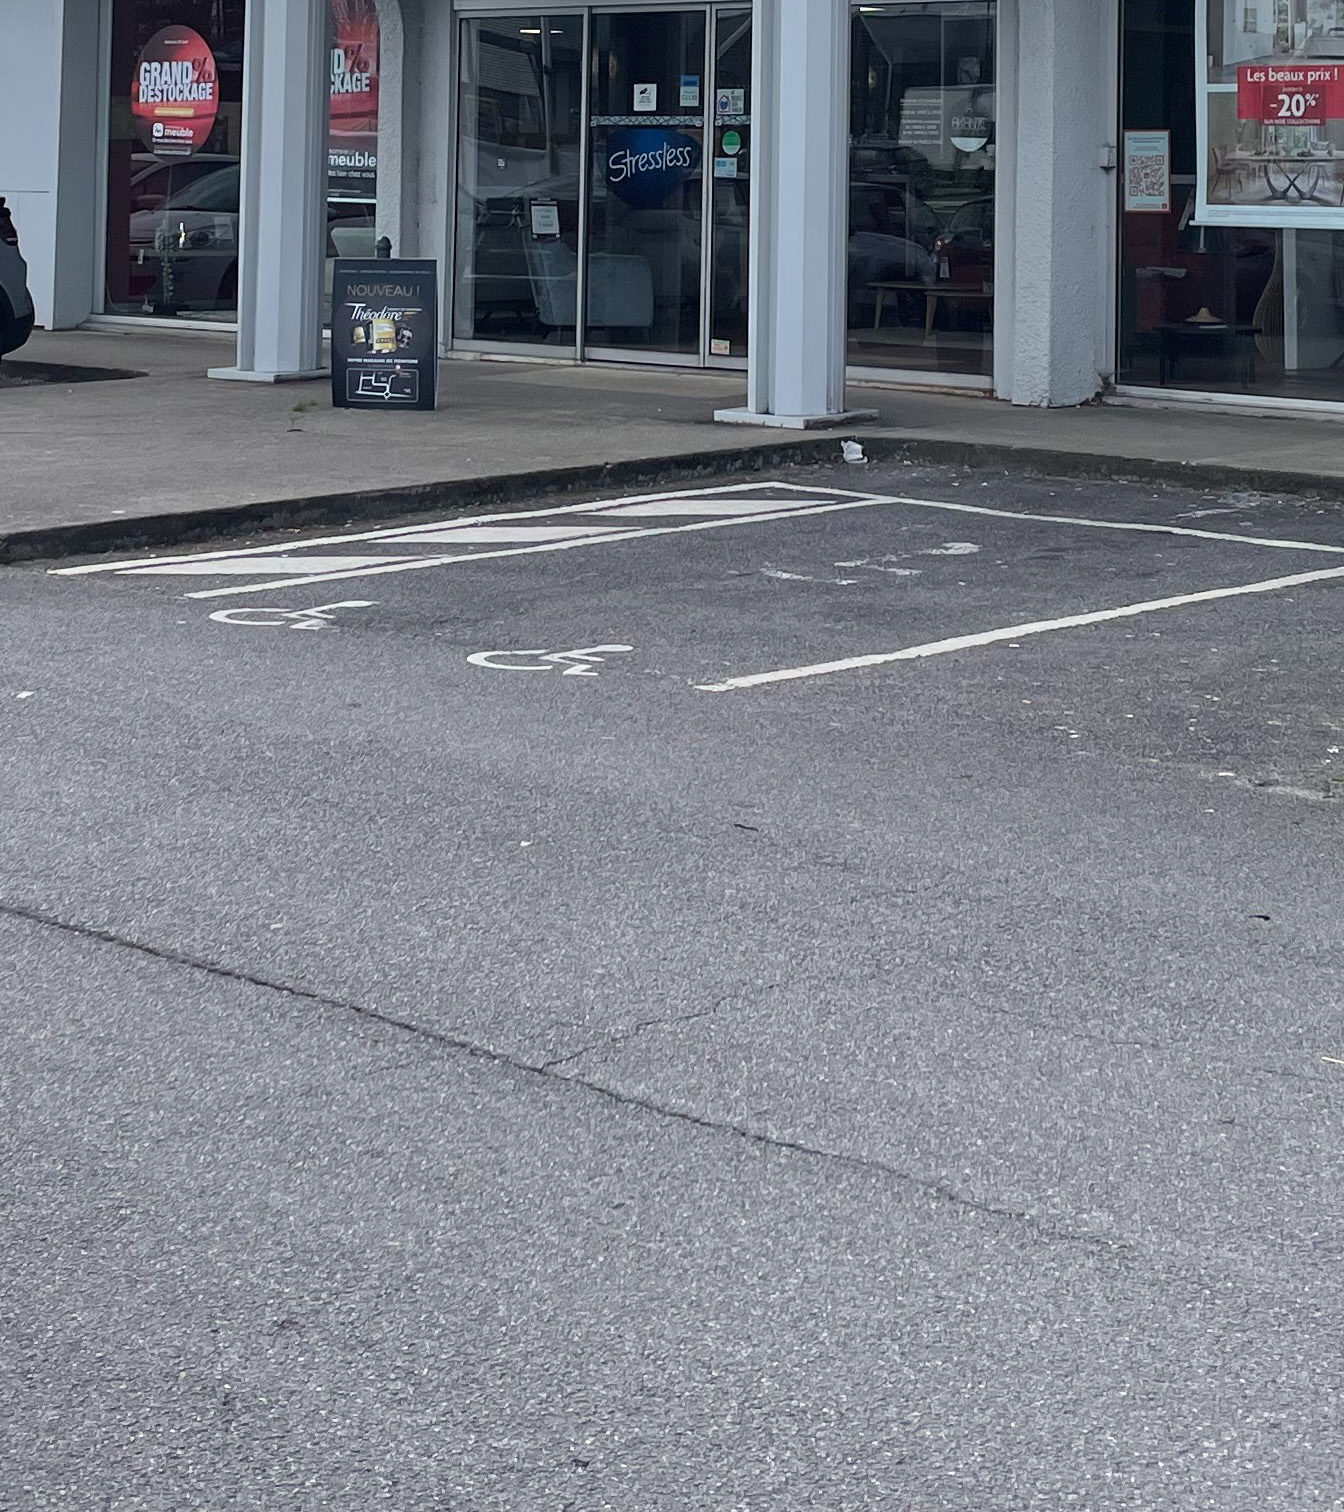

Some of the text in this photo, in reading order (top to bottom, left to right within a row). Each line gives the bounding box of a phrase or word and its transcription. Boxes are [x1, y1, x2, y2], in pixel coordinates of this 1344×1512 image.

[140, 61, 193, 87] GRAND
[1247, 69, 1265, 82] Les
[1268, 67, 1304, 81] beaux
[1307, 68, 1331, 85] prix
[139, 82, 213, 104] DESTOCKAGE
[609, 141, 692, 182] Stressless
[347, 284, 413, 297] NOUVEAU
[345, 302, 403, 321] Théodore
